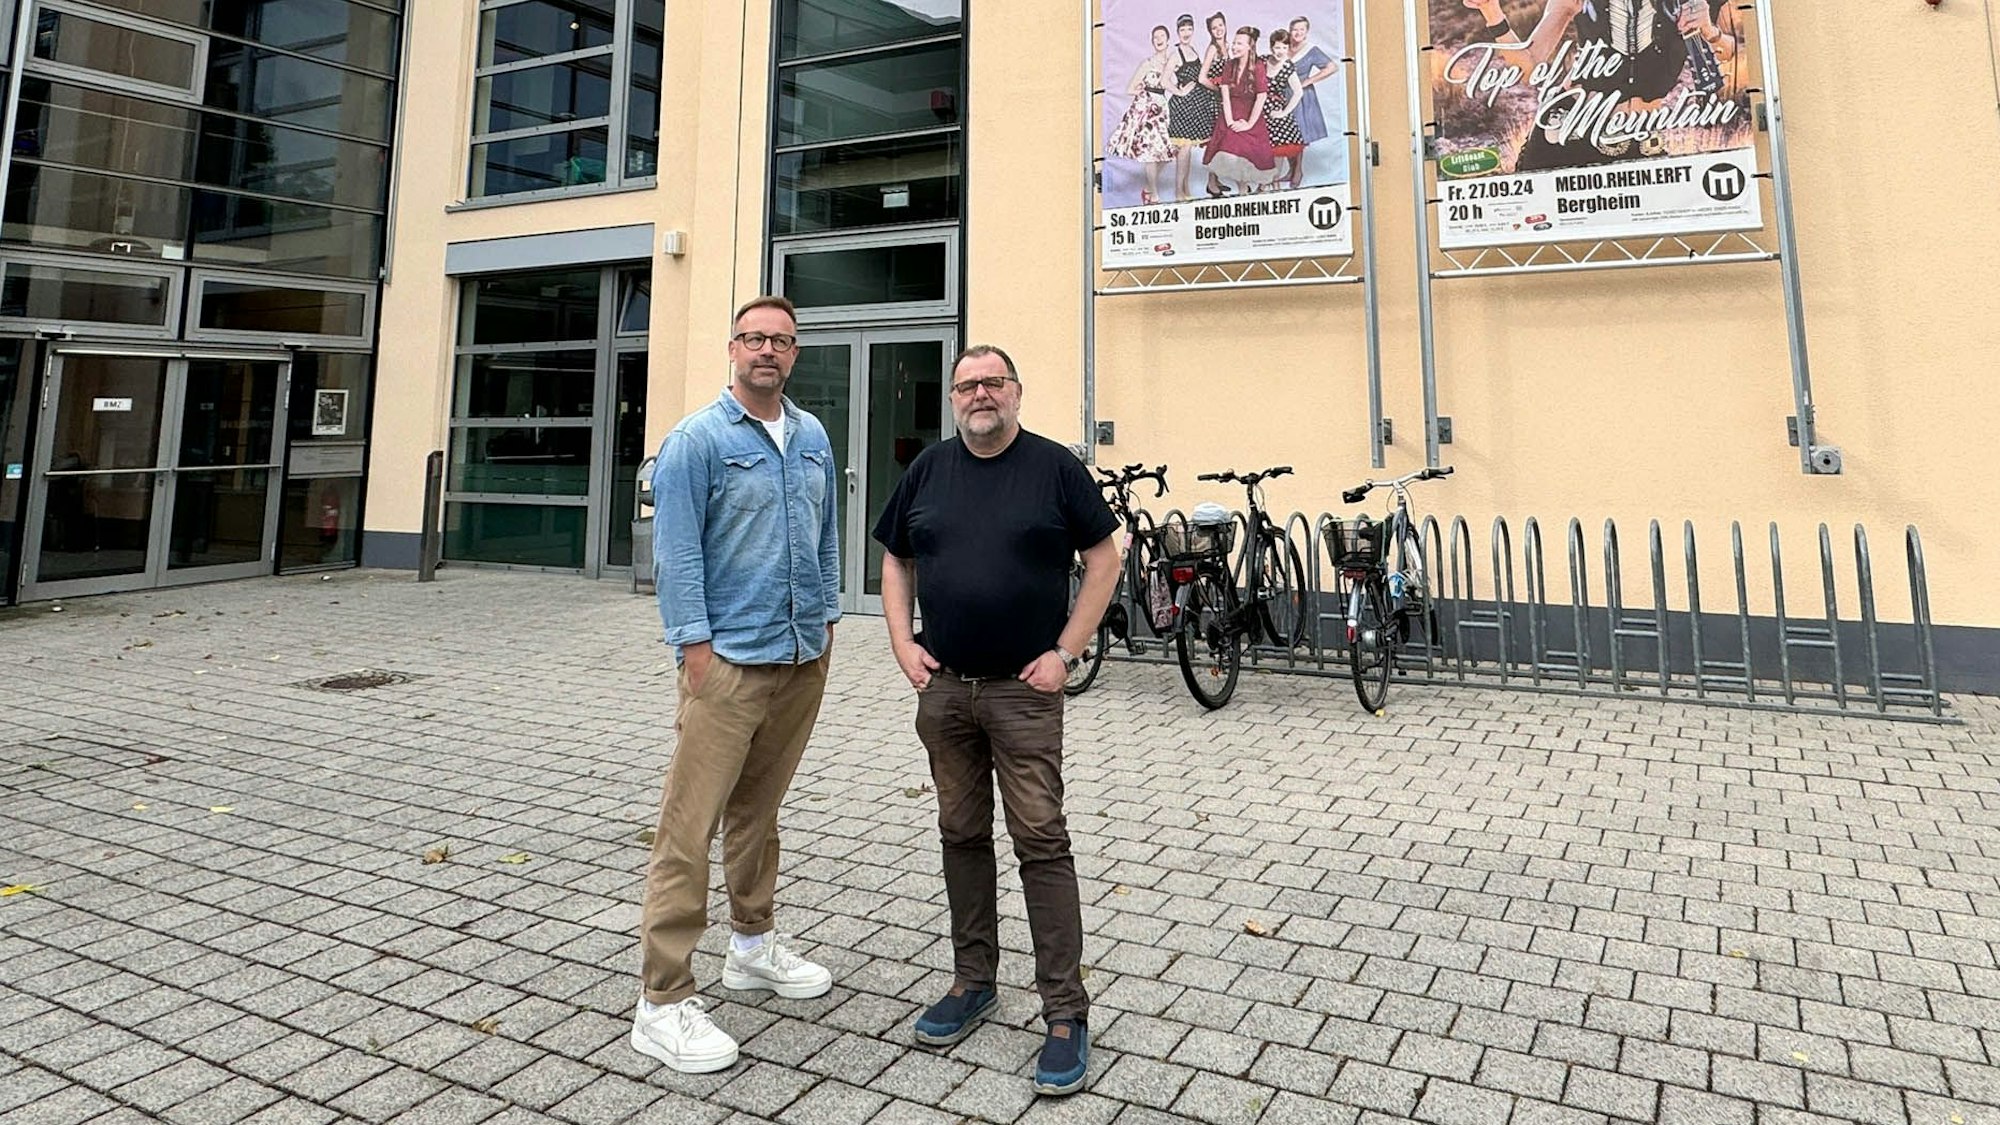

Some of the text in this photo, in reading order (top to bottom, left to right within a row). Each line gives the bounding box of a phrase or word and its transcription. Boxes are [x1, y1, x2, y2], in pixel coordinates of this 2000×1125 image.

[1443, 38, 1624, 108] Top of the
[1536, 86, 1739, 146] Mountain
[1555, 166, 1692, 192] MEDIO.RHEIN.ERFT
[1448, 179, 1534, 201] Fr. 27.09.24
[1195, 199, 1301, 221] MEDIO.RHEIN.ERFT
[1449, 205, 1468, 221] 20
[1472, 204, 1483, 219] h
[1557, 193, 1641, 214] Bergheim
[1110, 208, 1179, 227] So. 27.10.24
[1110, 230, 1124, 245] 15
[1127, 230, 1135, 244] h
[1195, 222, 1260, 240] Bergheim
